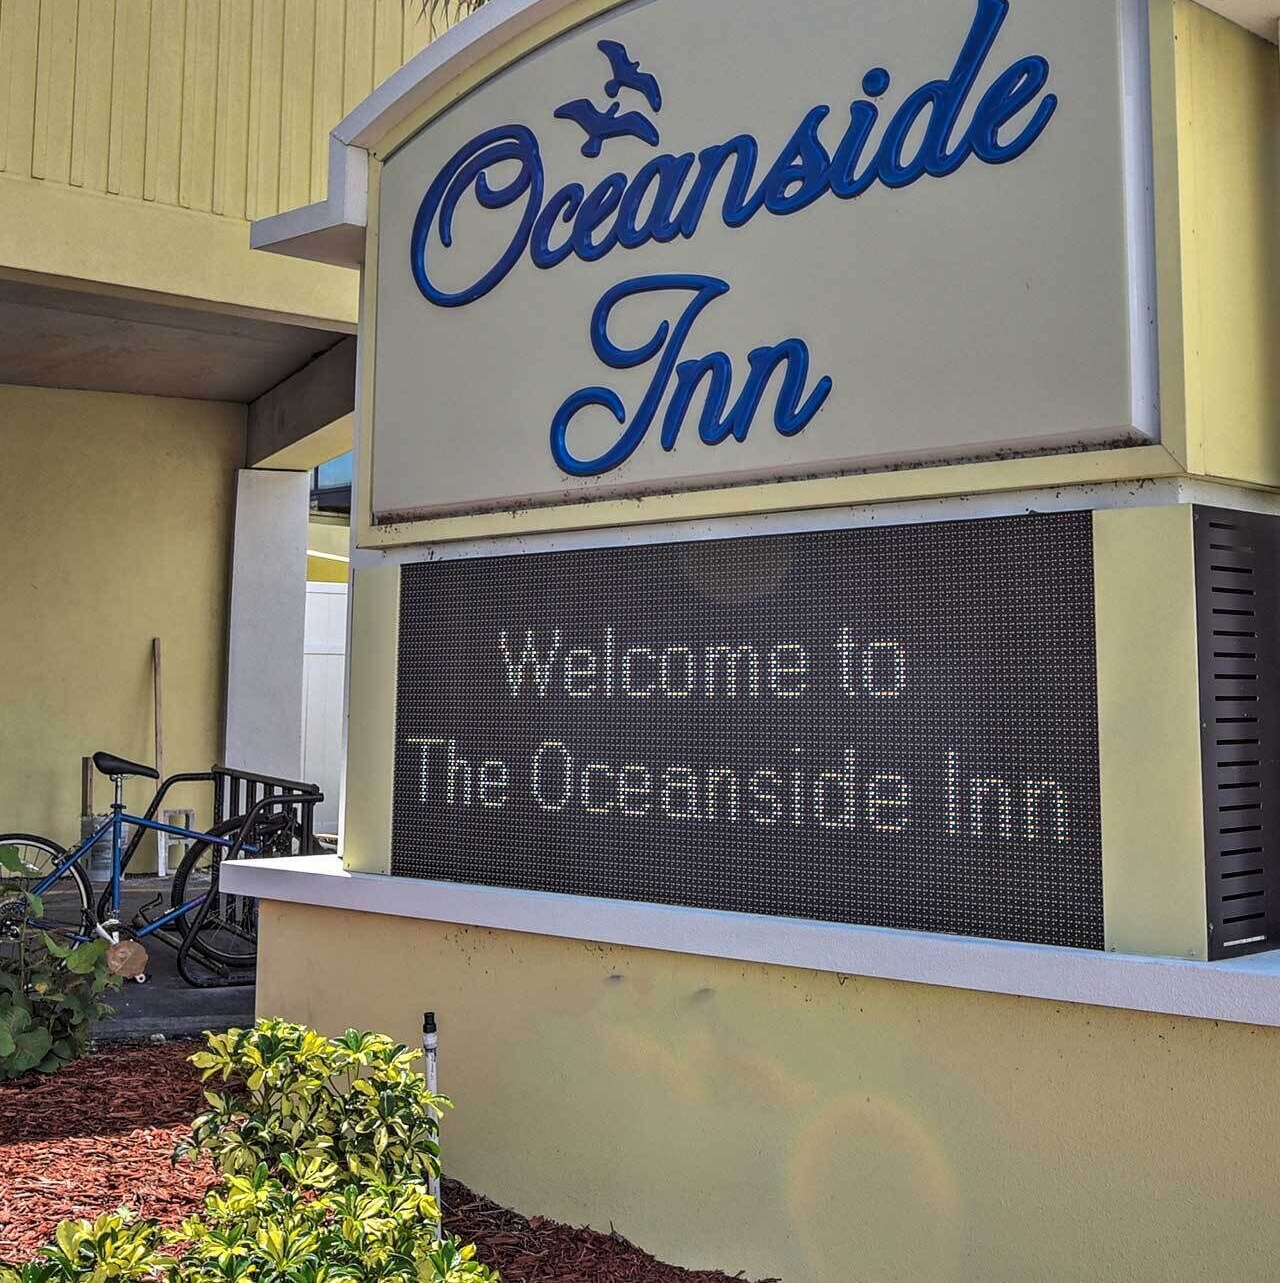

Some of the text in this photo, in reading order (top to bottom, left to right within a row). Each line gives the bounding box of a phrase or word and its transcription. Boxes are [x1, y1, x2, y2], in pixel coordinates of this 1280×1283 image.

[550, 274, 832, 477] Inn
[498, 627, 907, 698] Welcome to
[407, 737, 1070, 842] The Oceanside Inn
